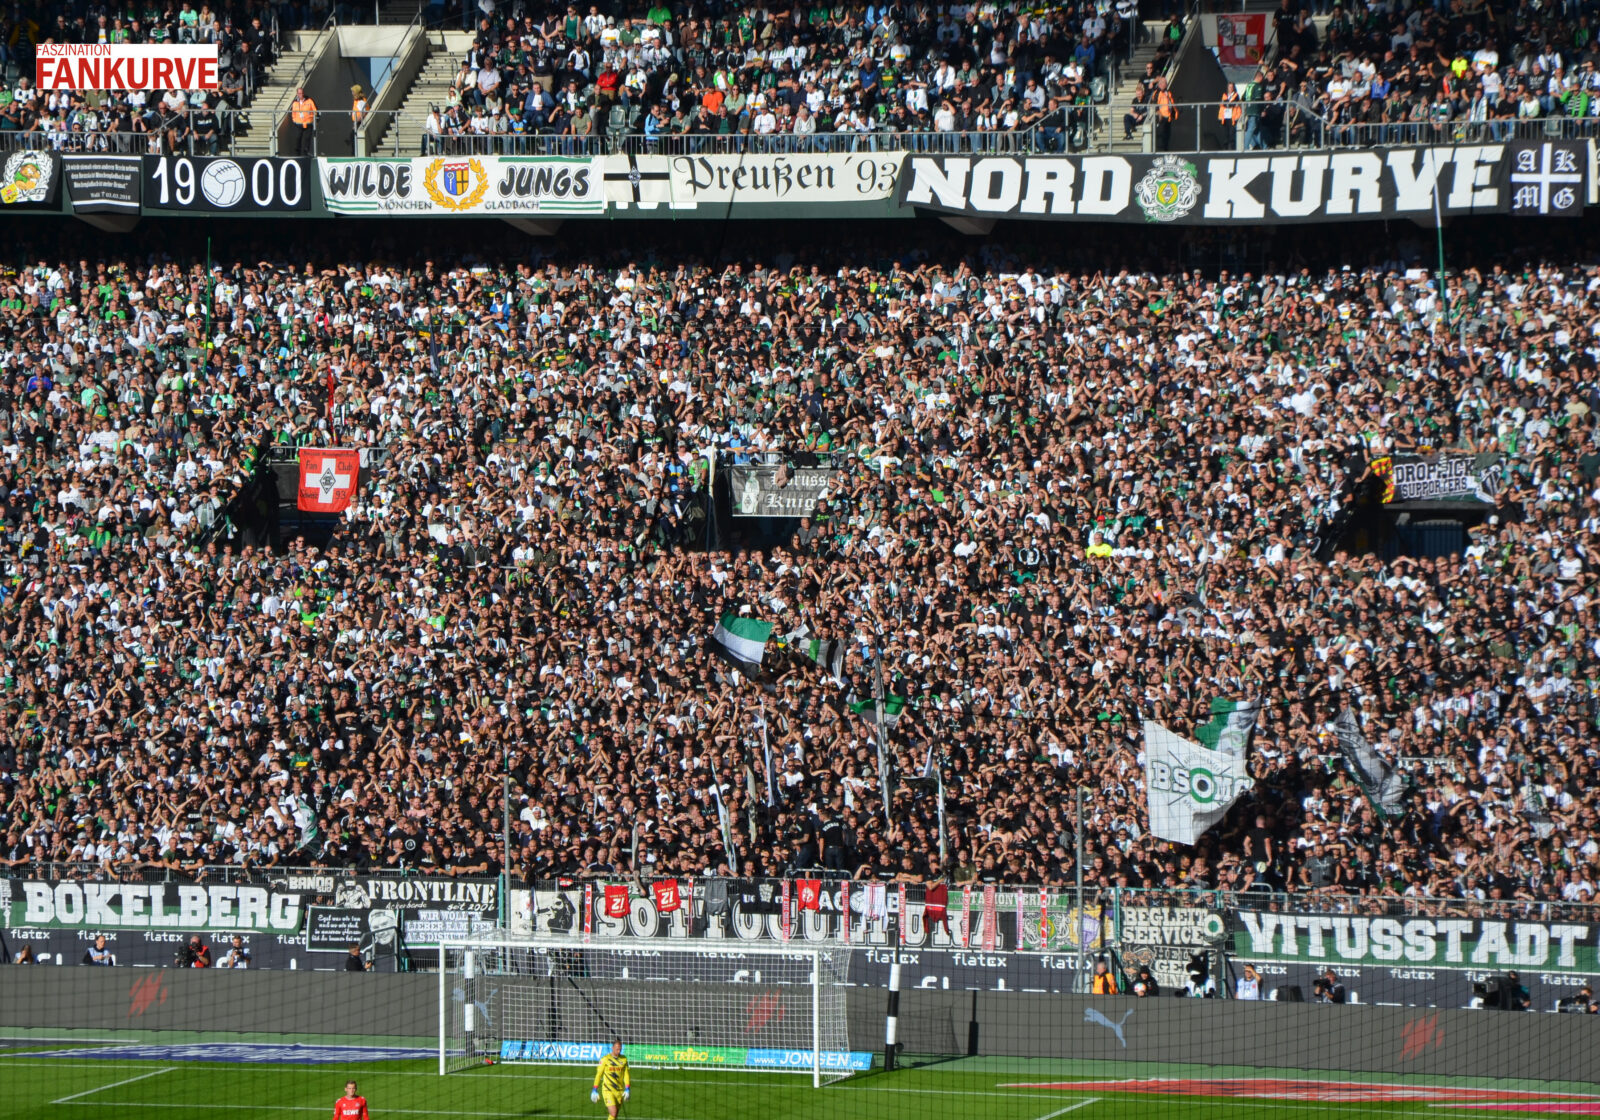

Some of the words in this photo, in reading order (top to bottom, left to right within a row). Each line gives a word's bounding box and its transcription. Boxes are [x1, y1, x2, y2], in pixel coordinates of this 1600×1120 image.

[1517, 149, 1538, 172] A
[152, 156, 195, 205] 19
[251, 158, 302, 206] 00
[328, 163, 411, 199] WILDE
[498, 165, 590, 198] JUNGS
[672, 156, 836, 197] Preußen
[905, 157, 1133, 216] NORD
[1203, 145, 1506, 219] KURVE
[377, 198, 432, 211] MÖNCHEN
[484, 199, 539, 211] GLADBACH
[306, 460, 318, 470] Fan
[338, 461, 353, 471] Club
[766, 493, 817, 511] Knig
[366, 879, 497, 904] FRONTLINE
[418, 910, 440, 921] WIR
[440, 910, 483, 921] WOLLN
[1121, 906, 1208, 926] BEGLEIT
[404, 921, 445, 932] LIEBER
[11, 929, 50, 940] flatex
[143, 931, 183, 942] flatex
[277, 934, 306, 945] flat
[1121, 926, 1204, 945] SERVICE
[1239, 911, 1589, 967] VITUSSTADT
[865, 951, 919, 965] flatex
[952, 953, 1007, 968] flatex
[1255, 965, 1287, 976] atex
[1390, 967, 1435, 981] flatex
[1540, 973, 1588, 987] flatex
[779, 1051, 849, 1067] JONGEN
